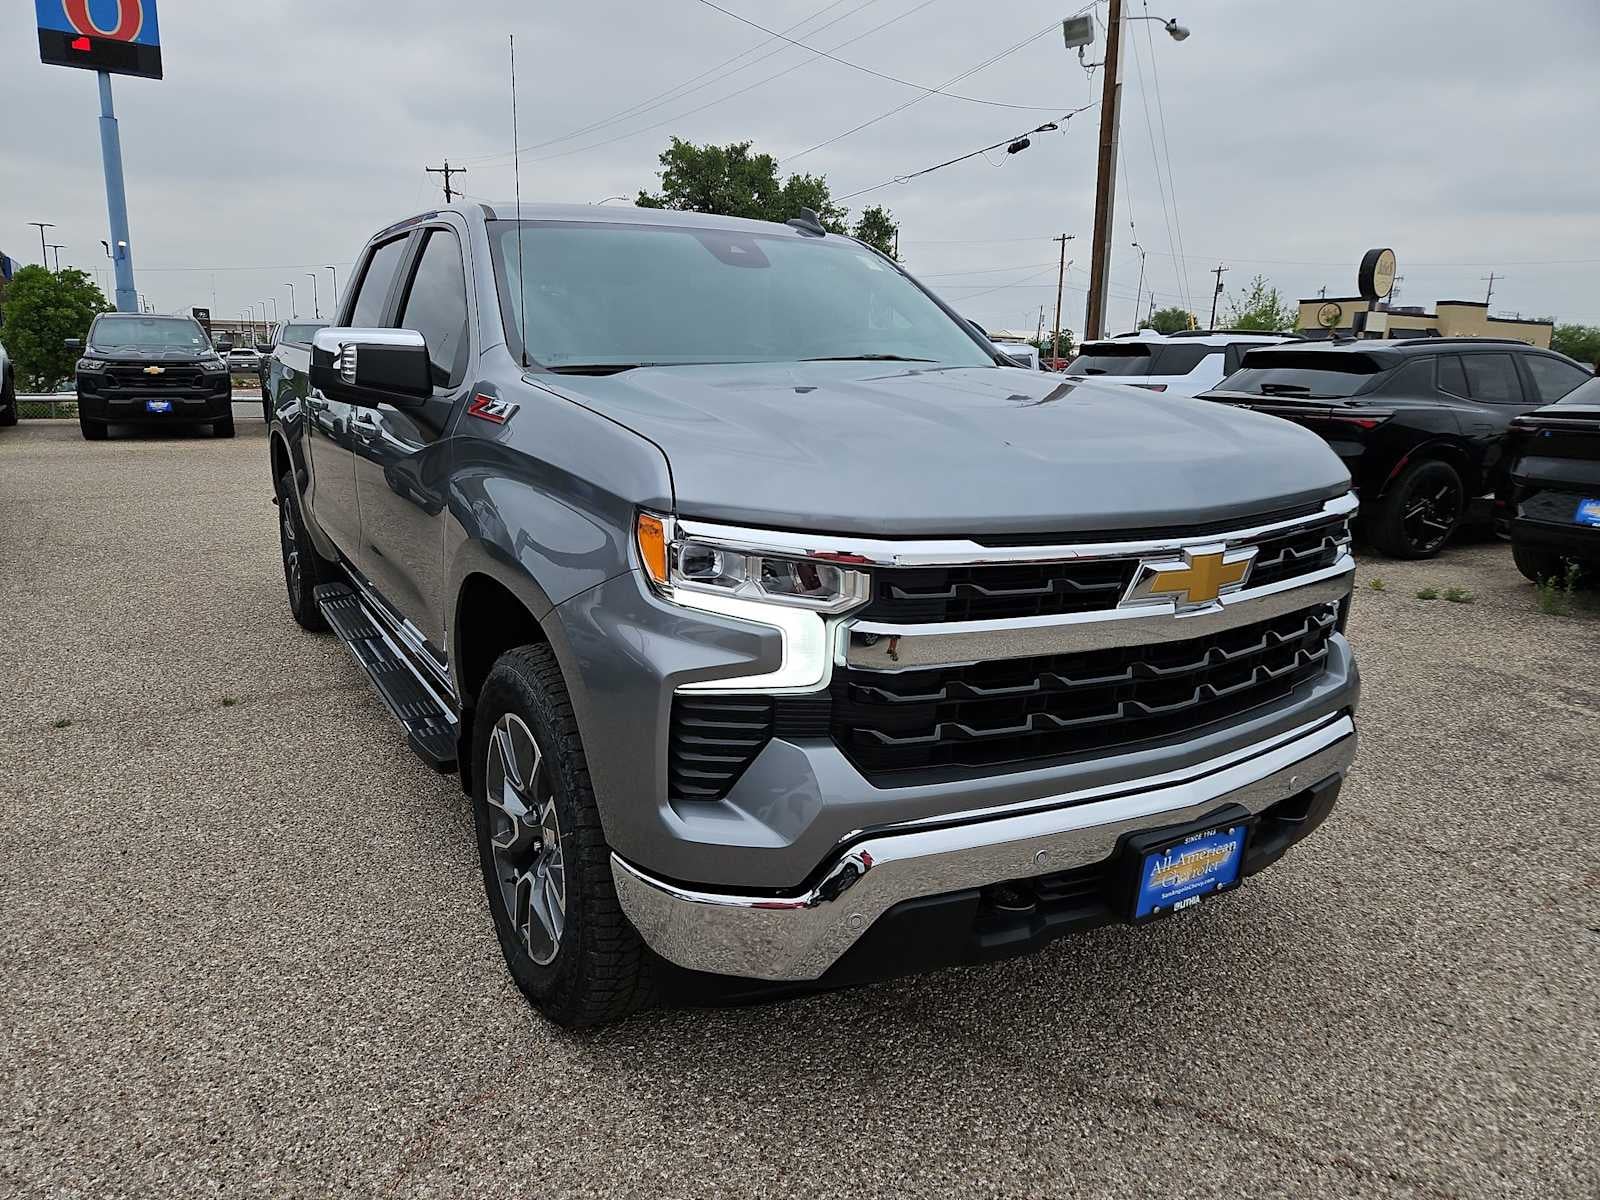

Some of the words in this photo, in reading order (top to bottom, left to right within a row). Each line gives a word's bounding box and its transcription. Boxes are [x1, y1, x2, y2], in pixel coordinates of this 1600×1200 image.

[467, 393, 520, 424] Z71
[1184, 833, 1202, 845] SINCE
[1150, 856, 1172, 877] All
[1175, 840, 1237, 866] American
